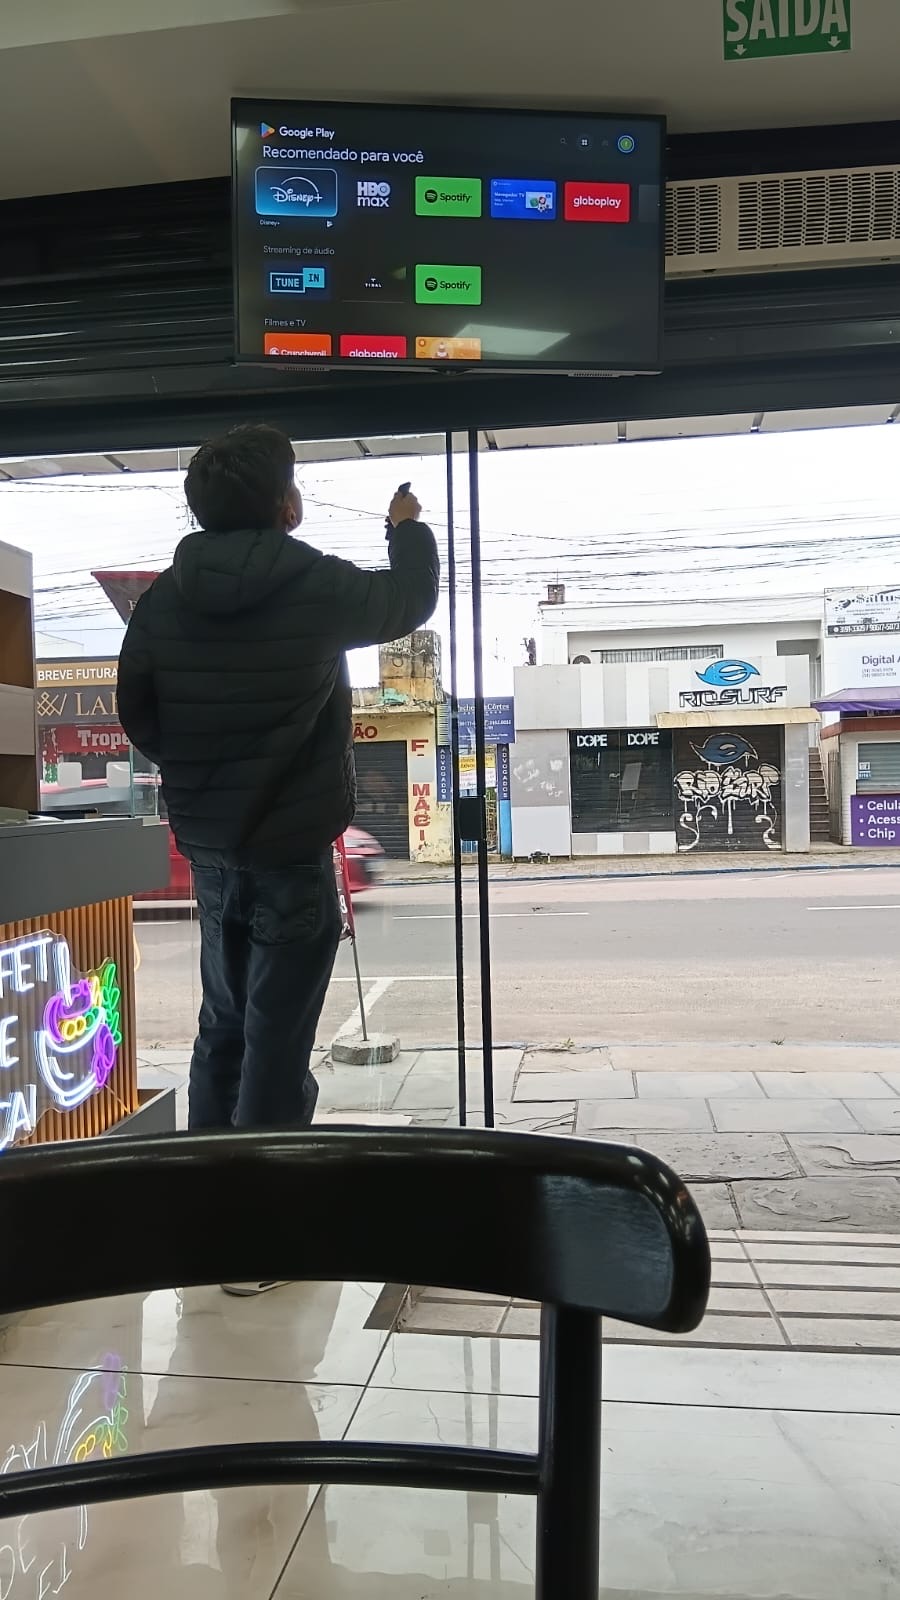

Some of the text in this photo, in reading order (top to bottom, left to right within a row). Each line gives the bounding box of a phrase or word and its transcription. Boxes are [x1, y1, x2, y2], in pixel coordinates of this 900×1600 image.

[279, 126, 335, 140] Google Play
[263, 145, 424, 163] Recomendado para você
[357, 181, 391, 197] HBO
[357, 197, 390, 207] max
[439, 192, 471, 202] Spotify
[573, 195, 621, 208] globoplay
[263, 245, 301, 256] Streaming
[302, 246, 312, 254] de
[275, 272, 320, 288] TUNE IN
[439, 280, 471, 290] Spotify
[264, 318, 288, 326] Filmes
[862, 655, 895, 667] Digital
[37, 669, 74, 681] BREVE
[576, 734, 608, 747] DOPE
[627, 732, 660, 746] DOPE
[867, 827, 896, 841] Chip
